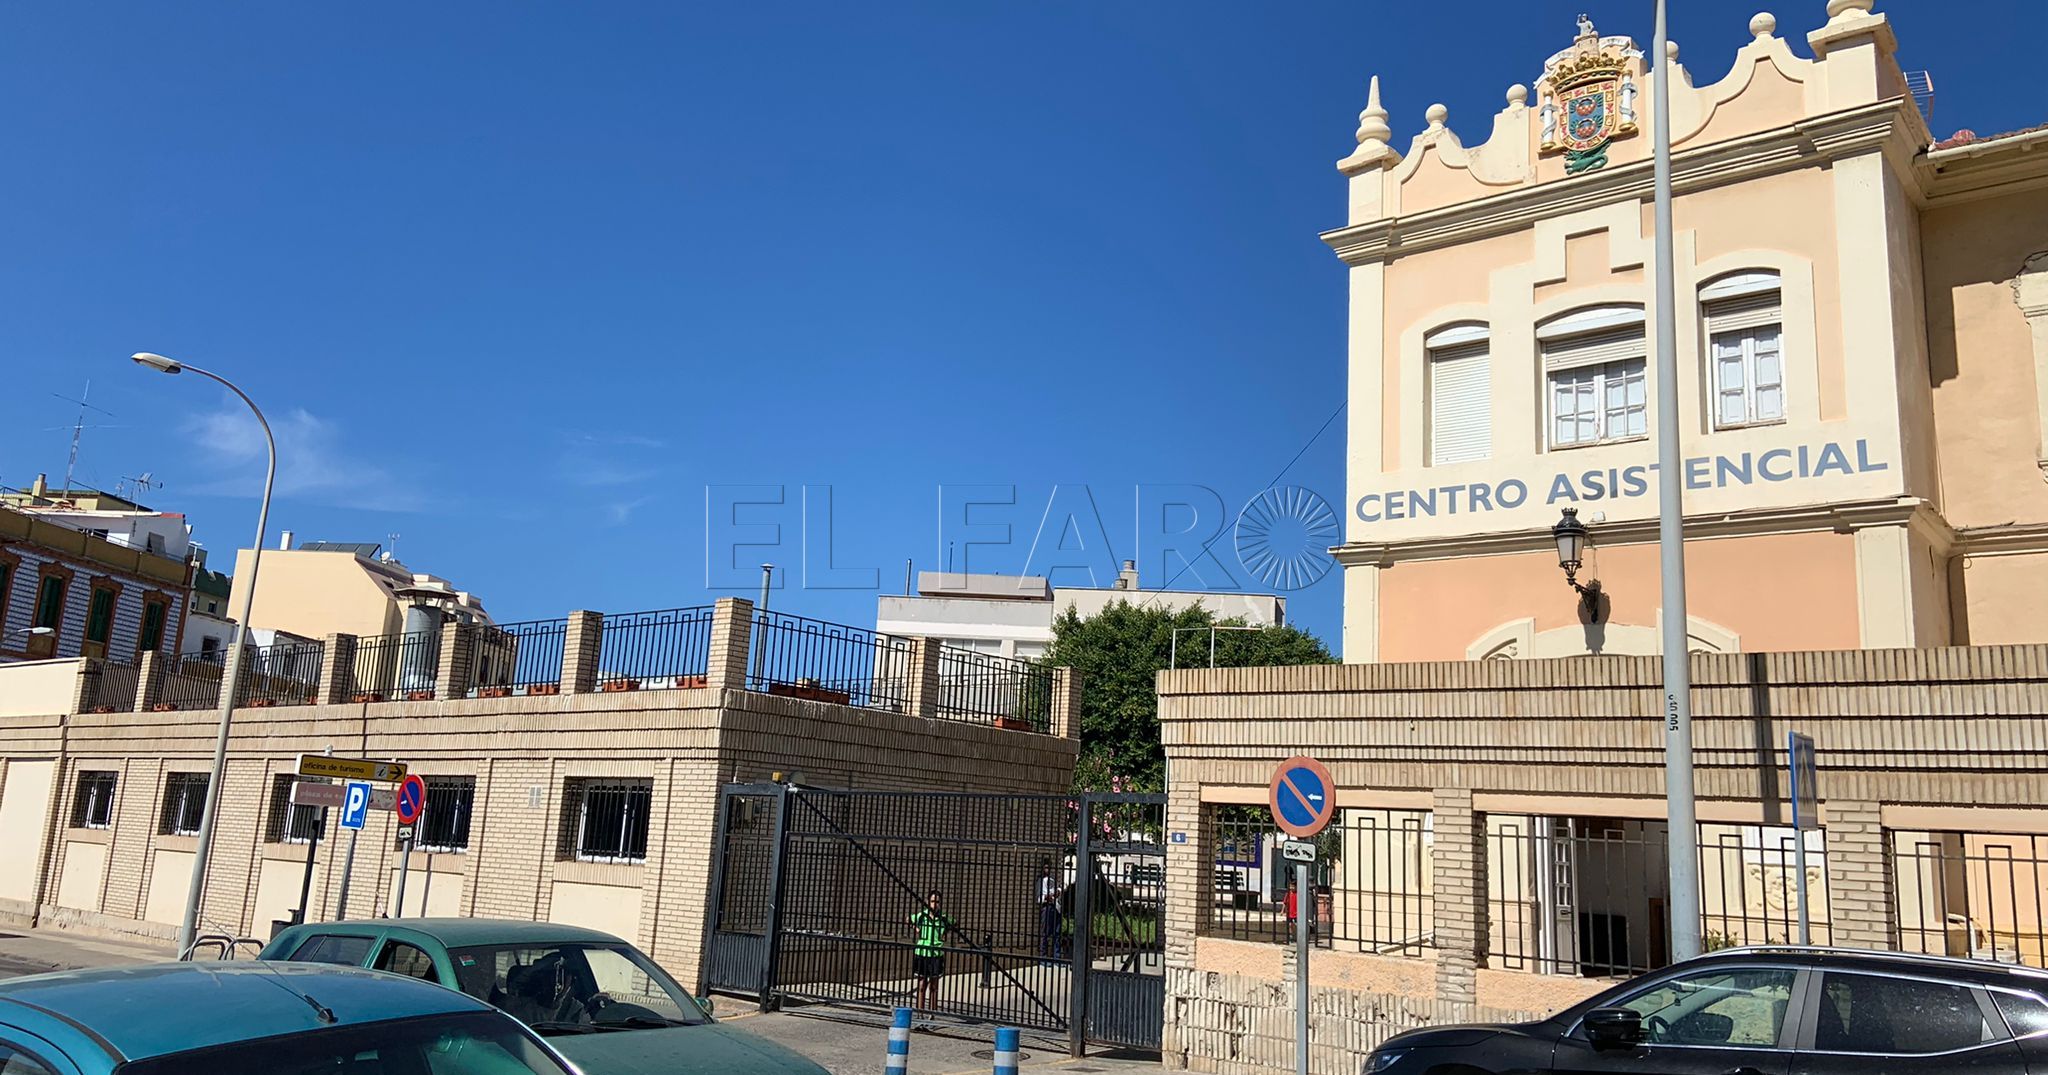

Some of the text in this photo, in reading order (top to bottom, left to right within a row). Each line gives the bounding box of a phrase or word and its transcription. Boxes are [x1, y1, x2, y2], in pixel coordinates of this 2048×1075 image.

[1356, 438, 1889, 523] CENTRO ASISENCIAL
[303, 762, 326, 770] oficina
[339, 765, 365, 774] turismo
[345, 787, 364, 822] P
